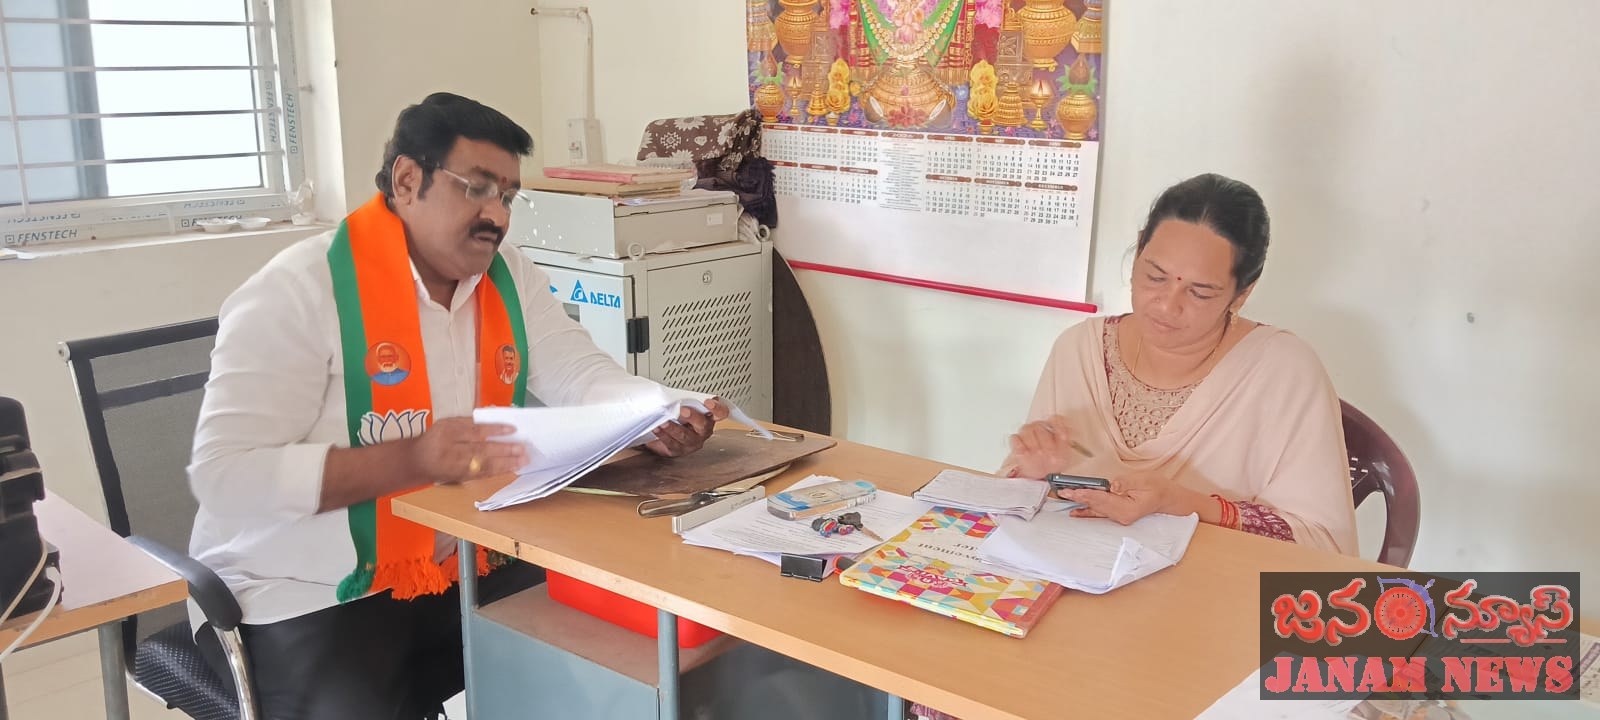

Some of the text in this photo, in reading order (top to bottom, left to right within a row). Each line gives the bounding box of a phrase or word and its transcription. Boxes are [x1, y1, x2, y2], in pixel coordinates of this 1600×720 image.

[286, 93, 298, 145] FENSTECH
[17, 229, 78, 243] FENSTECH
[590, 291, 621, 309] DELTA
[918, 543, 982, 563] ovement
